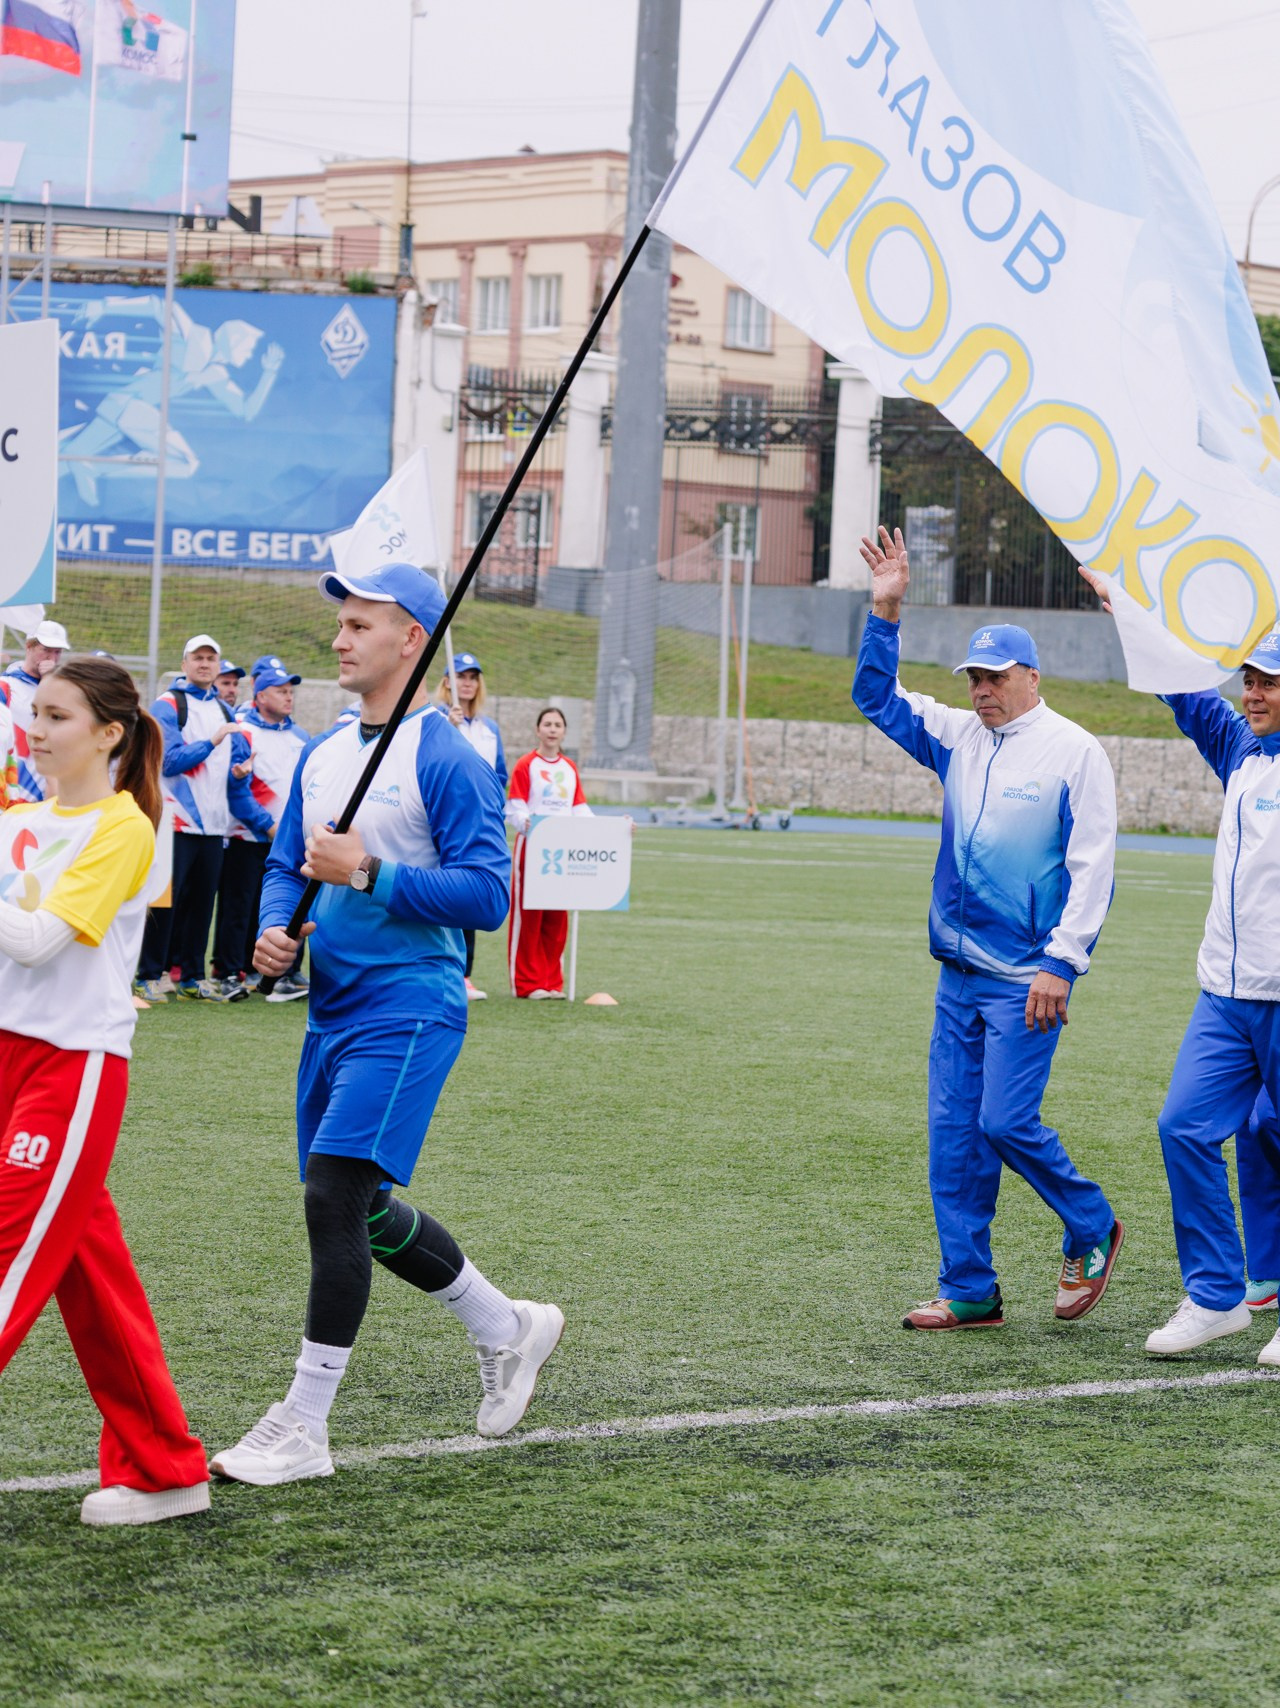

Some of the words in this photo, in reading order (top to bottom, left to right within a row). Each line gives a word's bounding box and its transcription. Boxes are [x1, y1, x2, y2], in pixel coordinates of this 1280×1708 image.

[730, 62, 1279, 671] МОЛОКО
[171, 528, 237, 558] ВСЕ
[1002, 791, 1040, 803] МОЛОКО
[567, 849, 617, 863] КОМОС
[8, 1131, 51, 1165] 20
